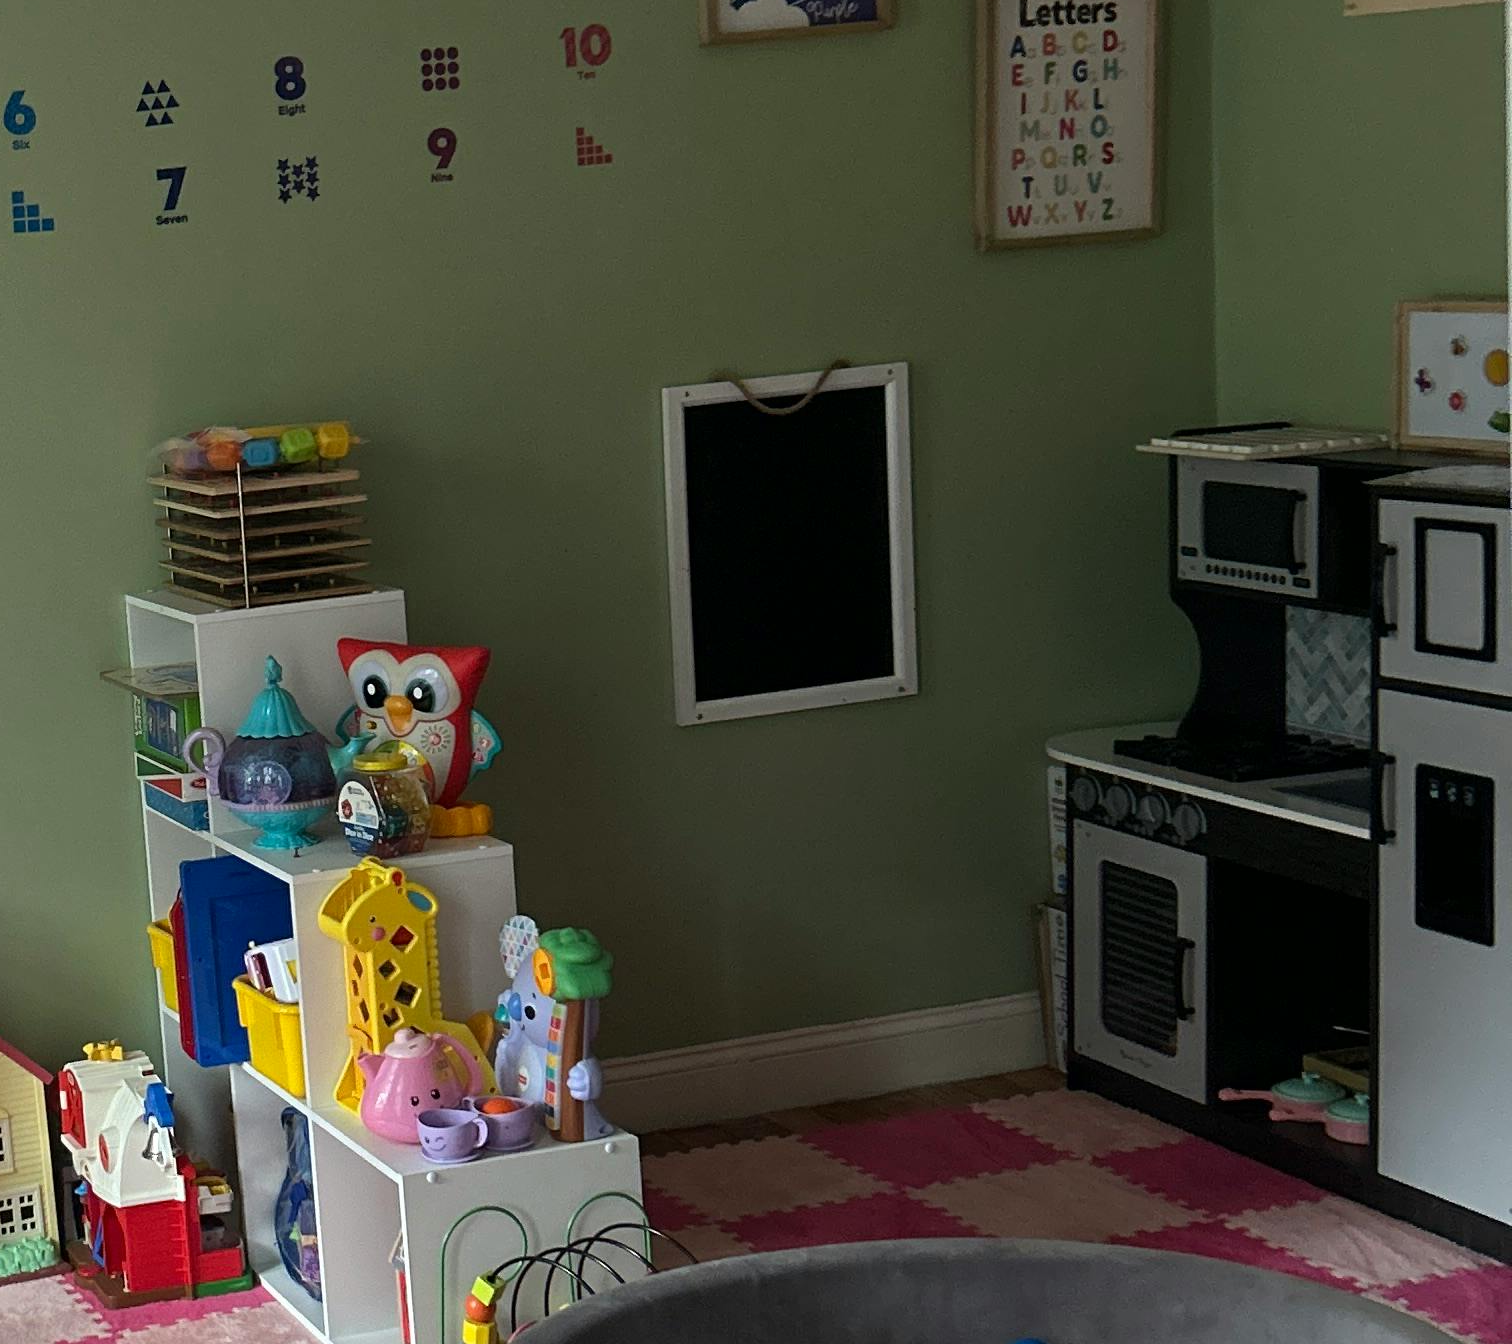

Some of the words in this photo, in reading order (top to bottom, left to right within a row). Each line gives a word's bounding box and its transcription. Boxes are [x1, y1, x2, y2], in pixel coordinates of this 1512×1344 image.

[559, 23, 611, 68] 10
[274, 55, 307, 101] 8
[3, 89, 37, 136] 6
[277, 103, 307, 117] Eight
[11, 139, 31, 151] Six
[426, 127, 458, 170] 9
[155, 165, 187, 211] 7
[155, 213, 189, 227] Seven
